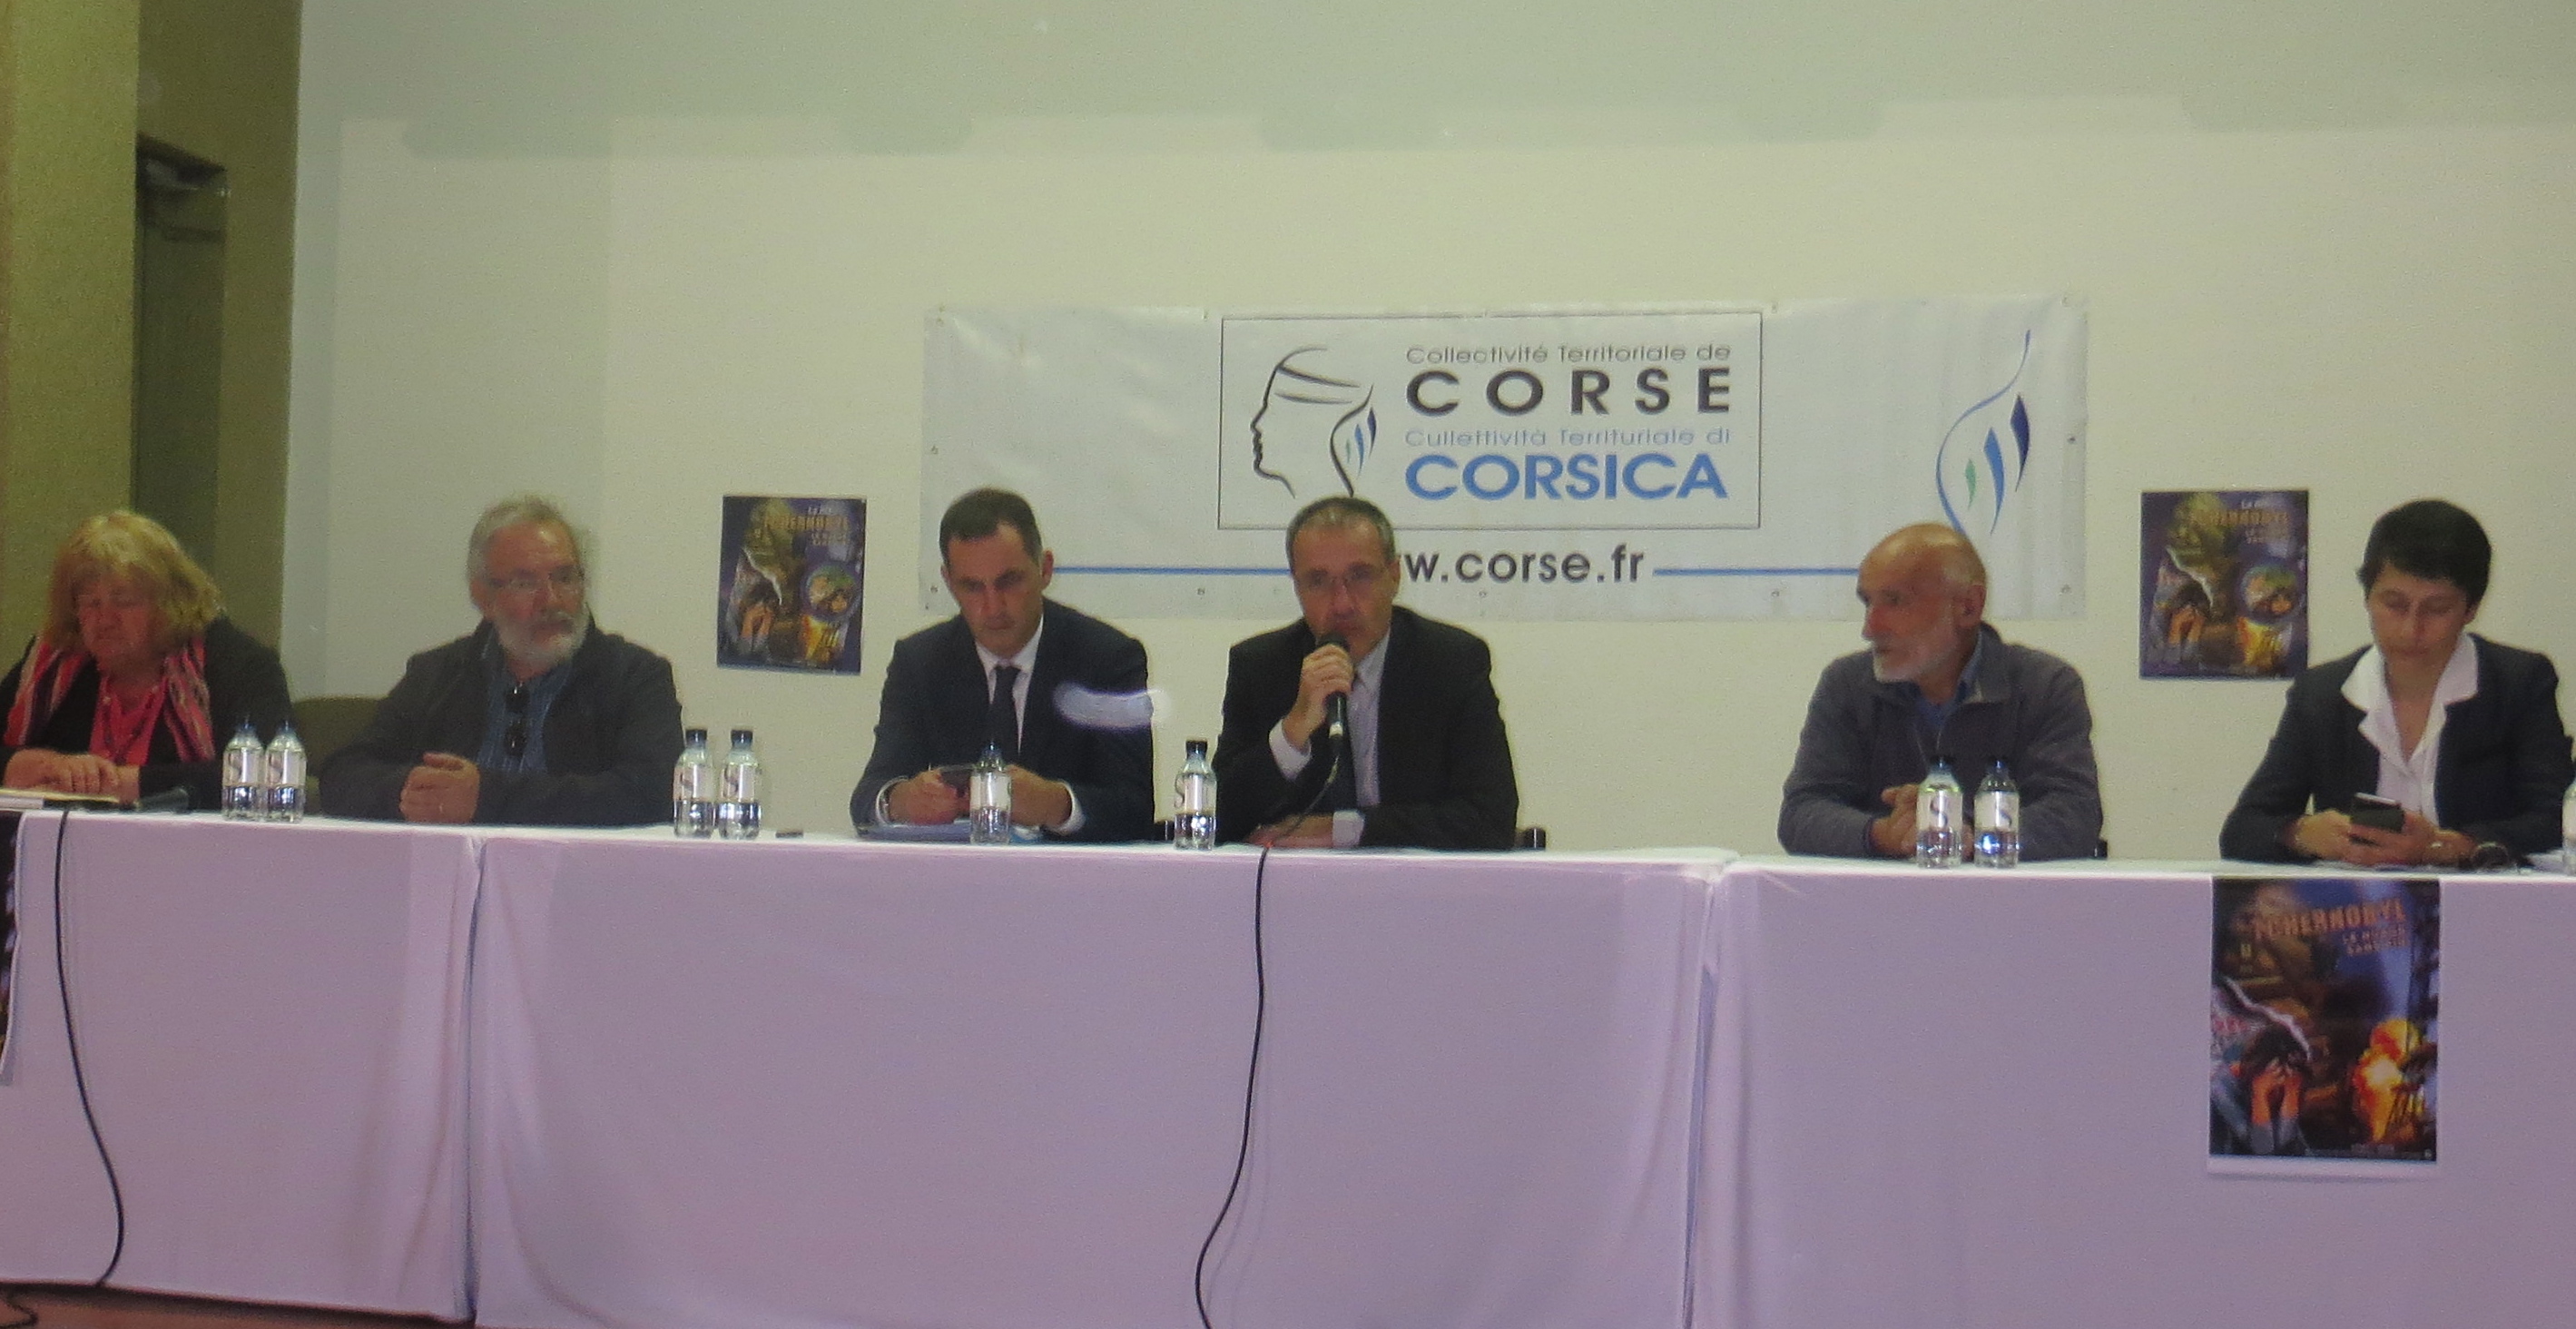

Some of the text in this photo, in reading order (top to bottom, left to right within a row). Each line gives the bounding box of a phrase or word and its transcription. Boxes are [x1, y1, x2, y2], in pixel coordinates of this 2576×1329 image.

[1406, 343, 1731, 363] Collectivité Territoriale de
[1406, 368, 1730, 417] CORSE
[1560, 428, 1695, 446] Territuriale
[1706, 428, 1730, 444] di
[1405, 453, 1728, 500] CORSICA
